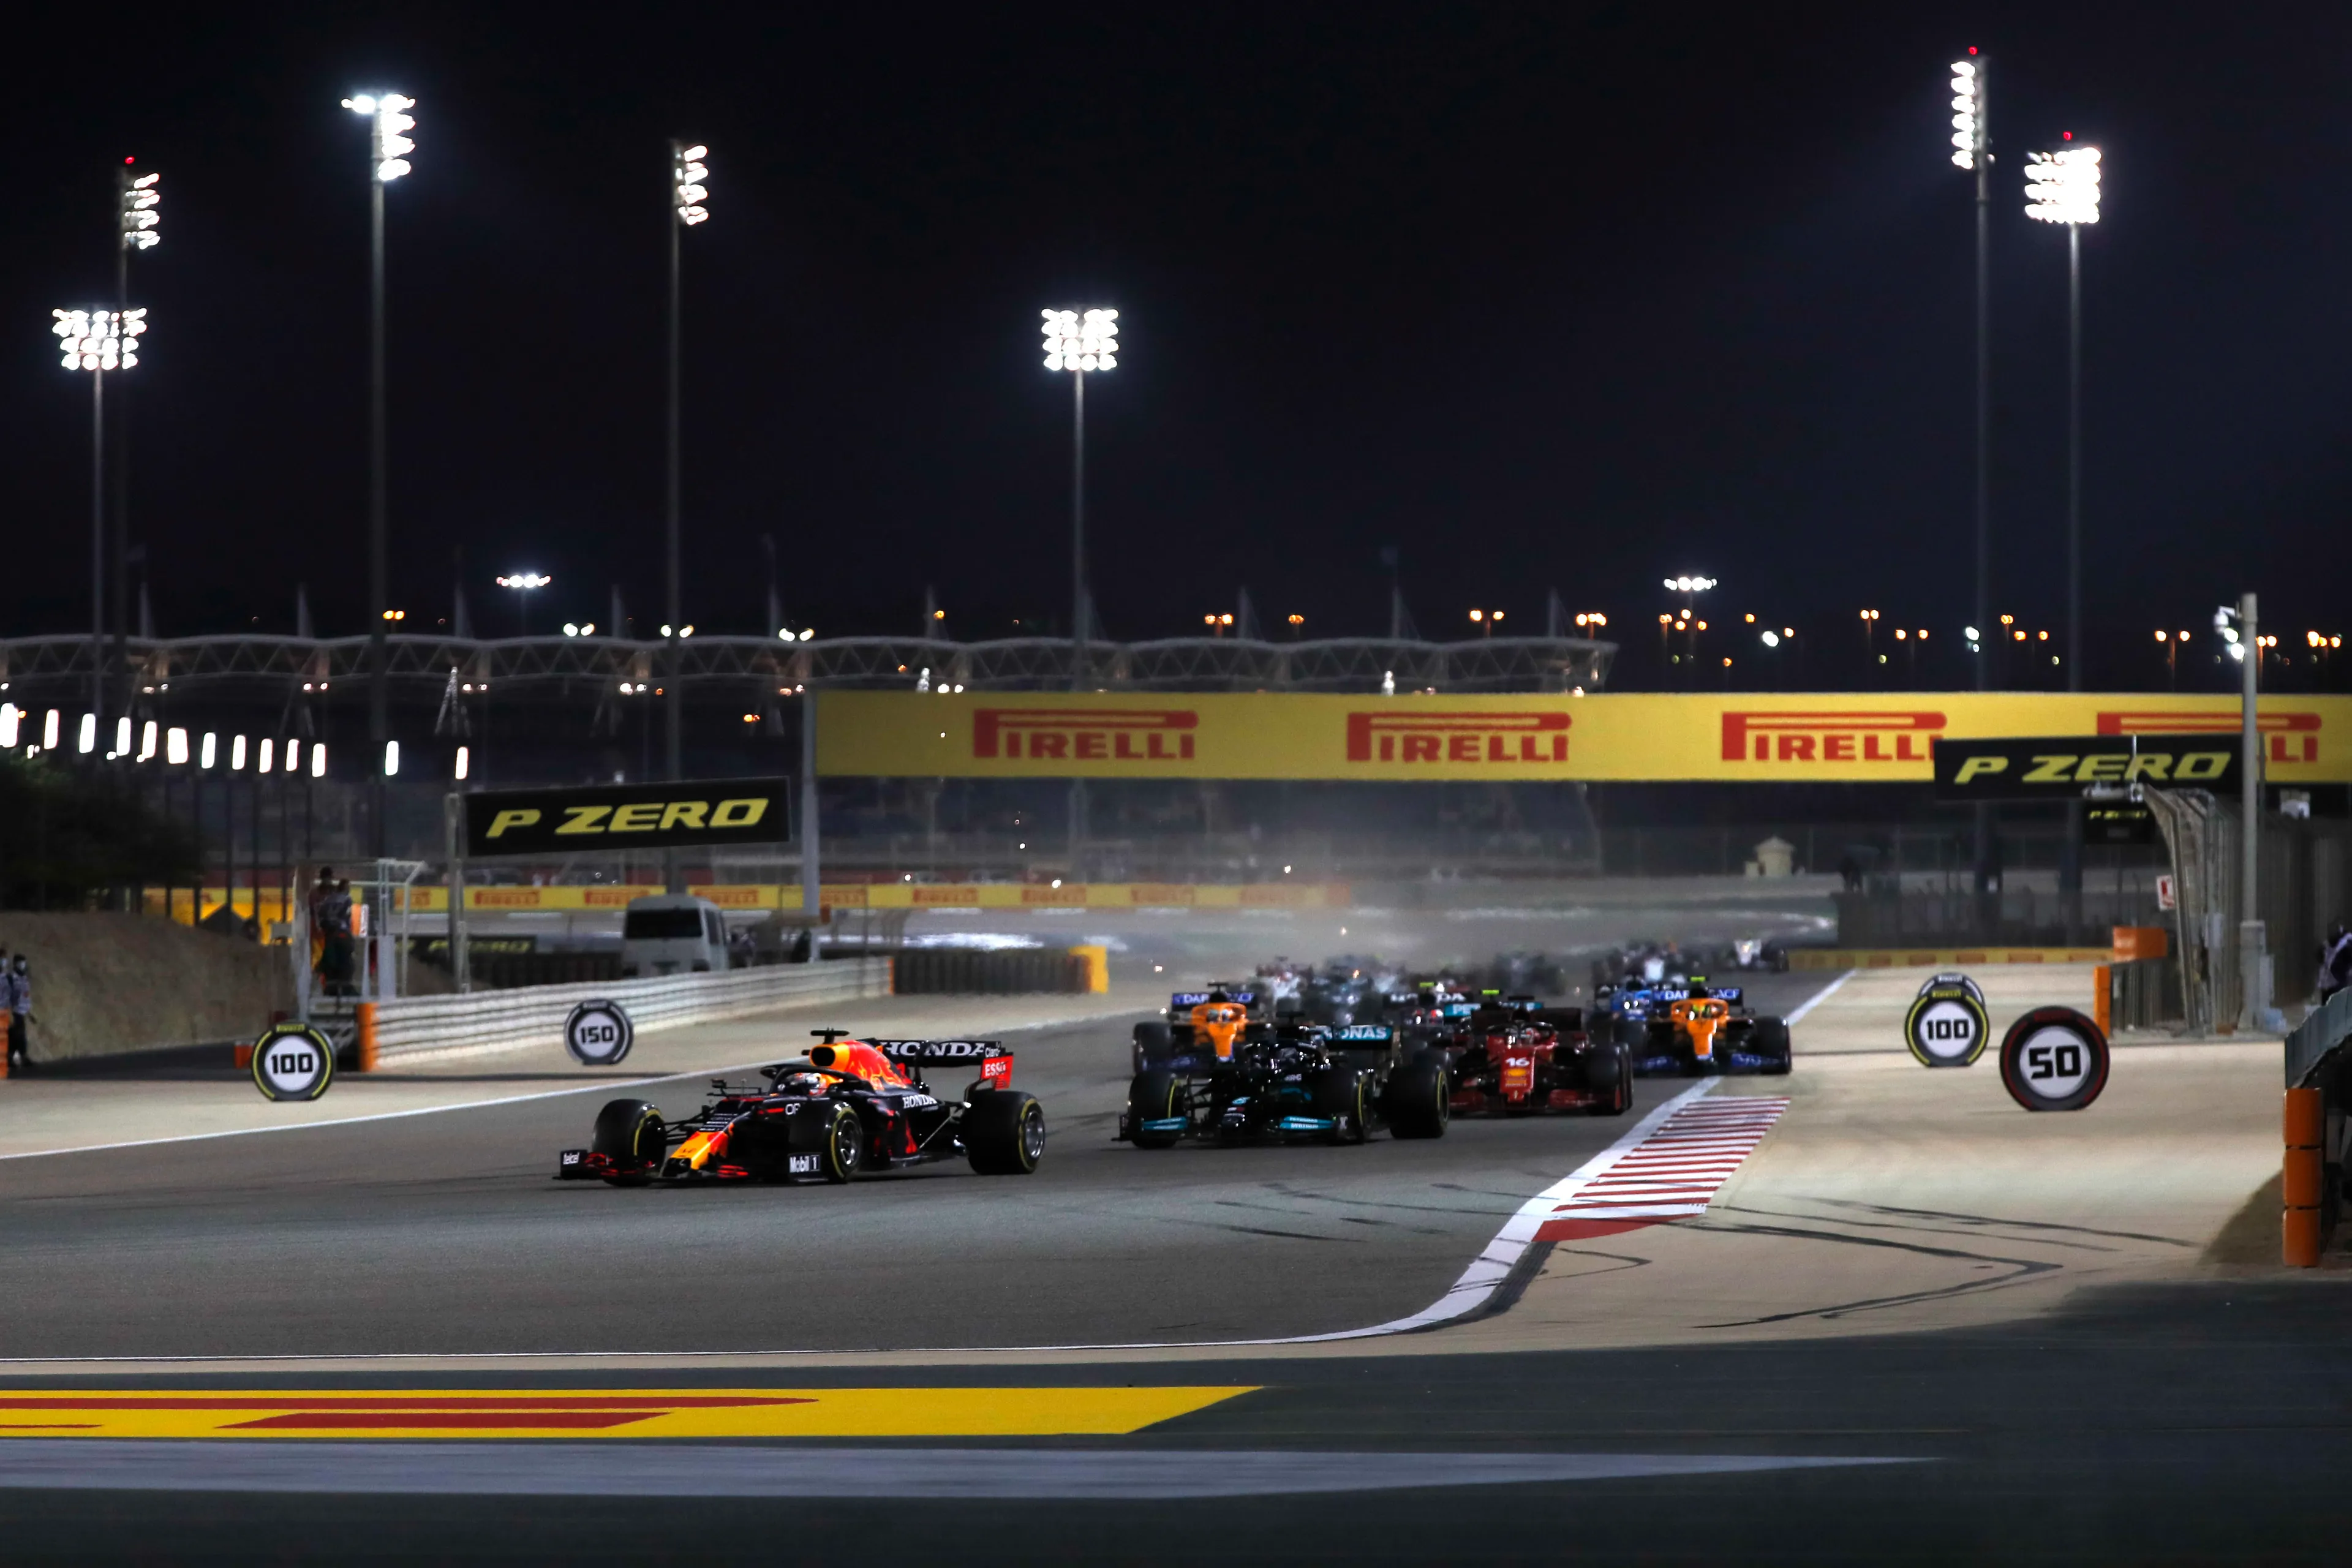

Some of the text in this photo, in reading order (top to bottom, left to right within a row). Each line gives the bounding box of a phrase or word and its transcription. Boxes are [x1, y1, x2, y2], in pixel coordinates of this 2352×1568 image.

[974, 709, 1198, 760] PIRELLI
[1348, 712, 1572, 761] PIRELLI
[1954, 752, 2232, 785] P ZERO
[486, 797, 769, 839] P ZERO
[581, 1025, 614, 1044] 150
[1927, 1019, 1969, 1040] 100
[880, 1041, 985, 1057] HONDA
[271, 1053, 313, 1074] 100
[1505, 1057, 1530, 1067] 16
[2029, 1045, 2081, 1080] 50
[902, 1094, 938, 1109] HONDA
[789, 1155, 810, 1174] Mobil
